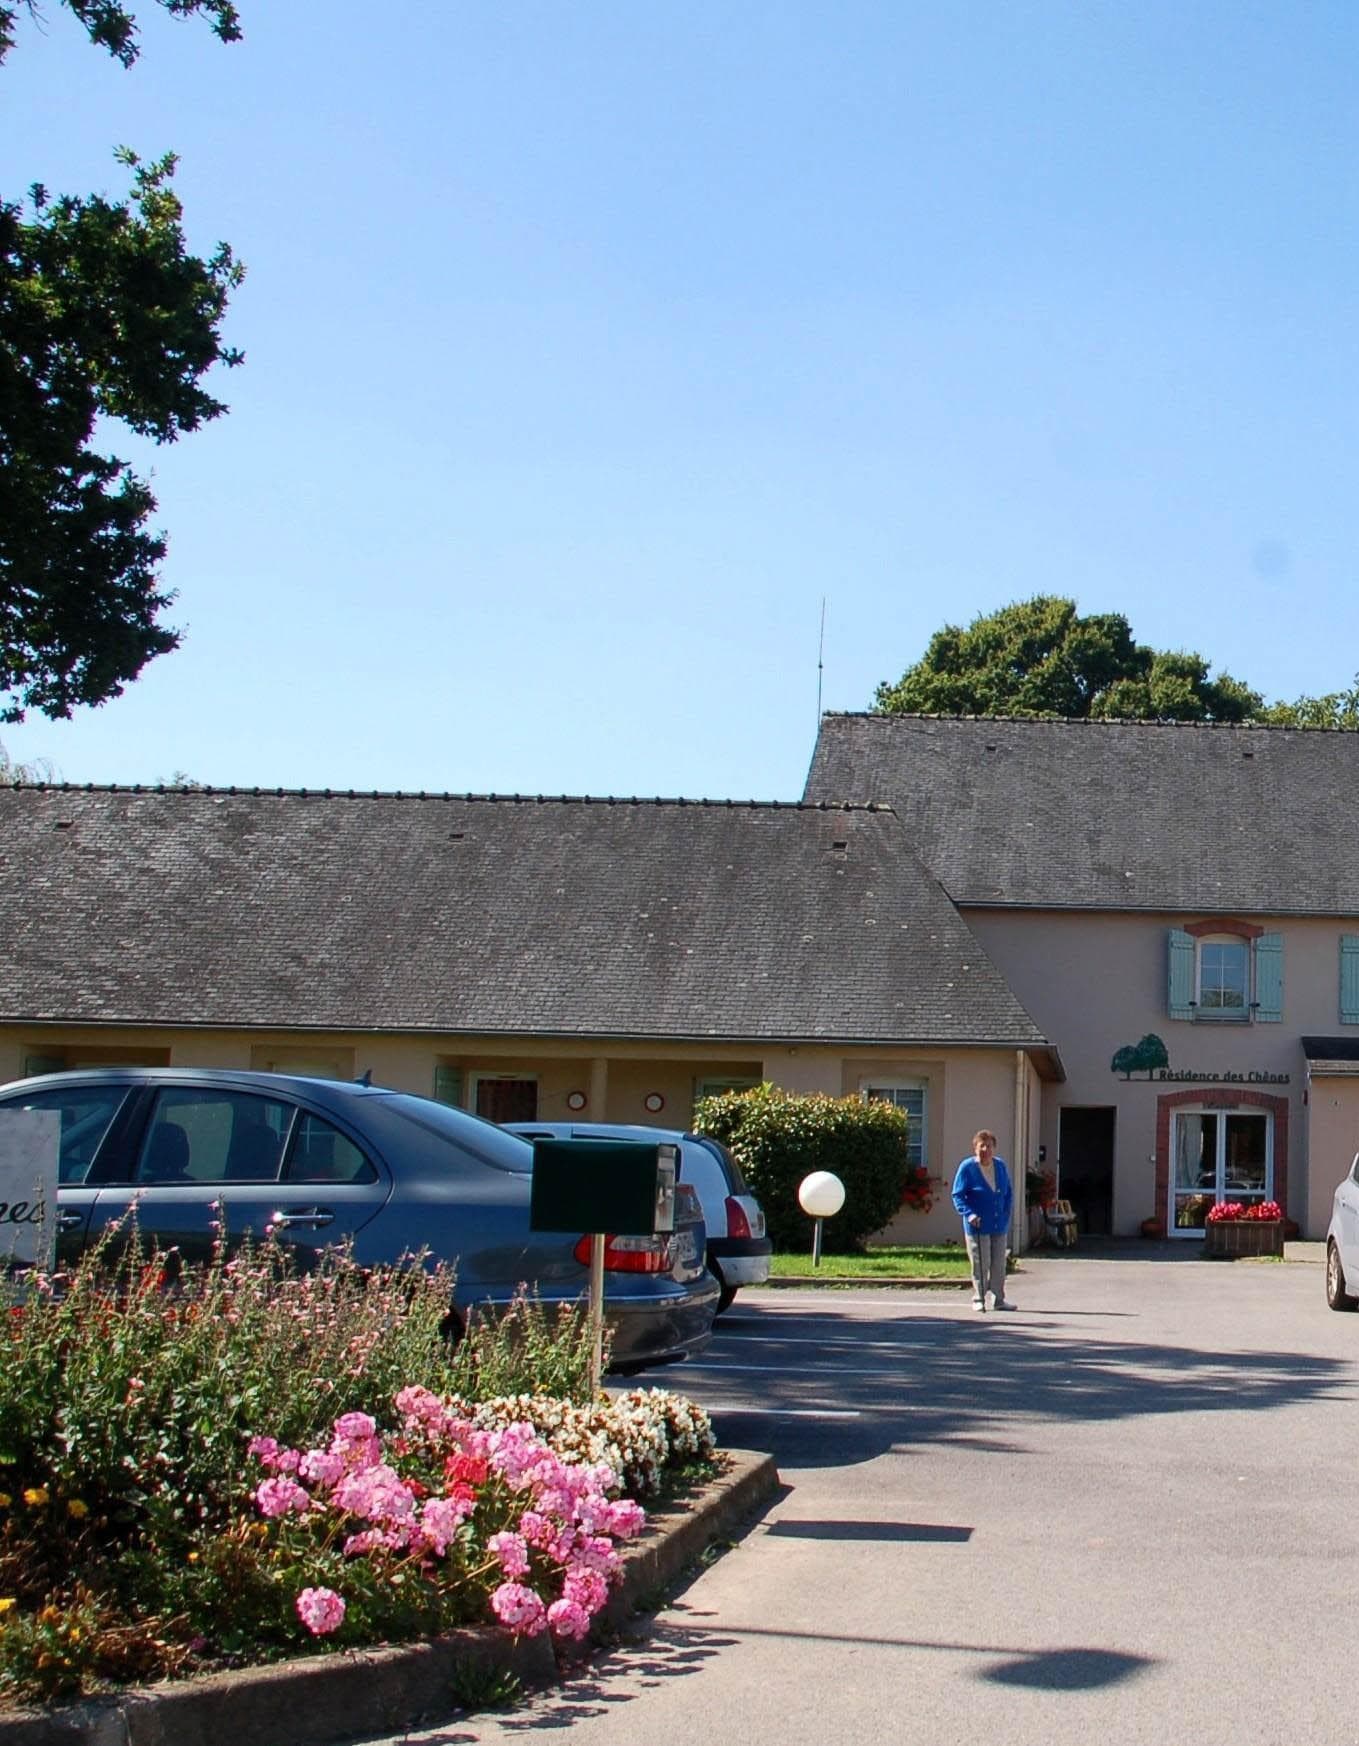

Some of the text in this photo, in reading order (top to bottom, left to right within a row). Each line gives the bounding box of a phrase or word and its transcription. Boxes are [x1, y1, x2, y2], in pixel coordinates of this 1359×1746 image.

[1160, 1069, 1290, 1083] Résidence des Chênes
